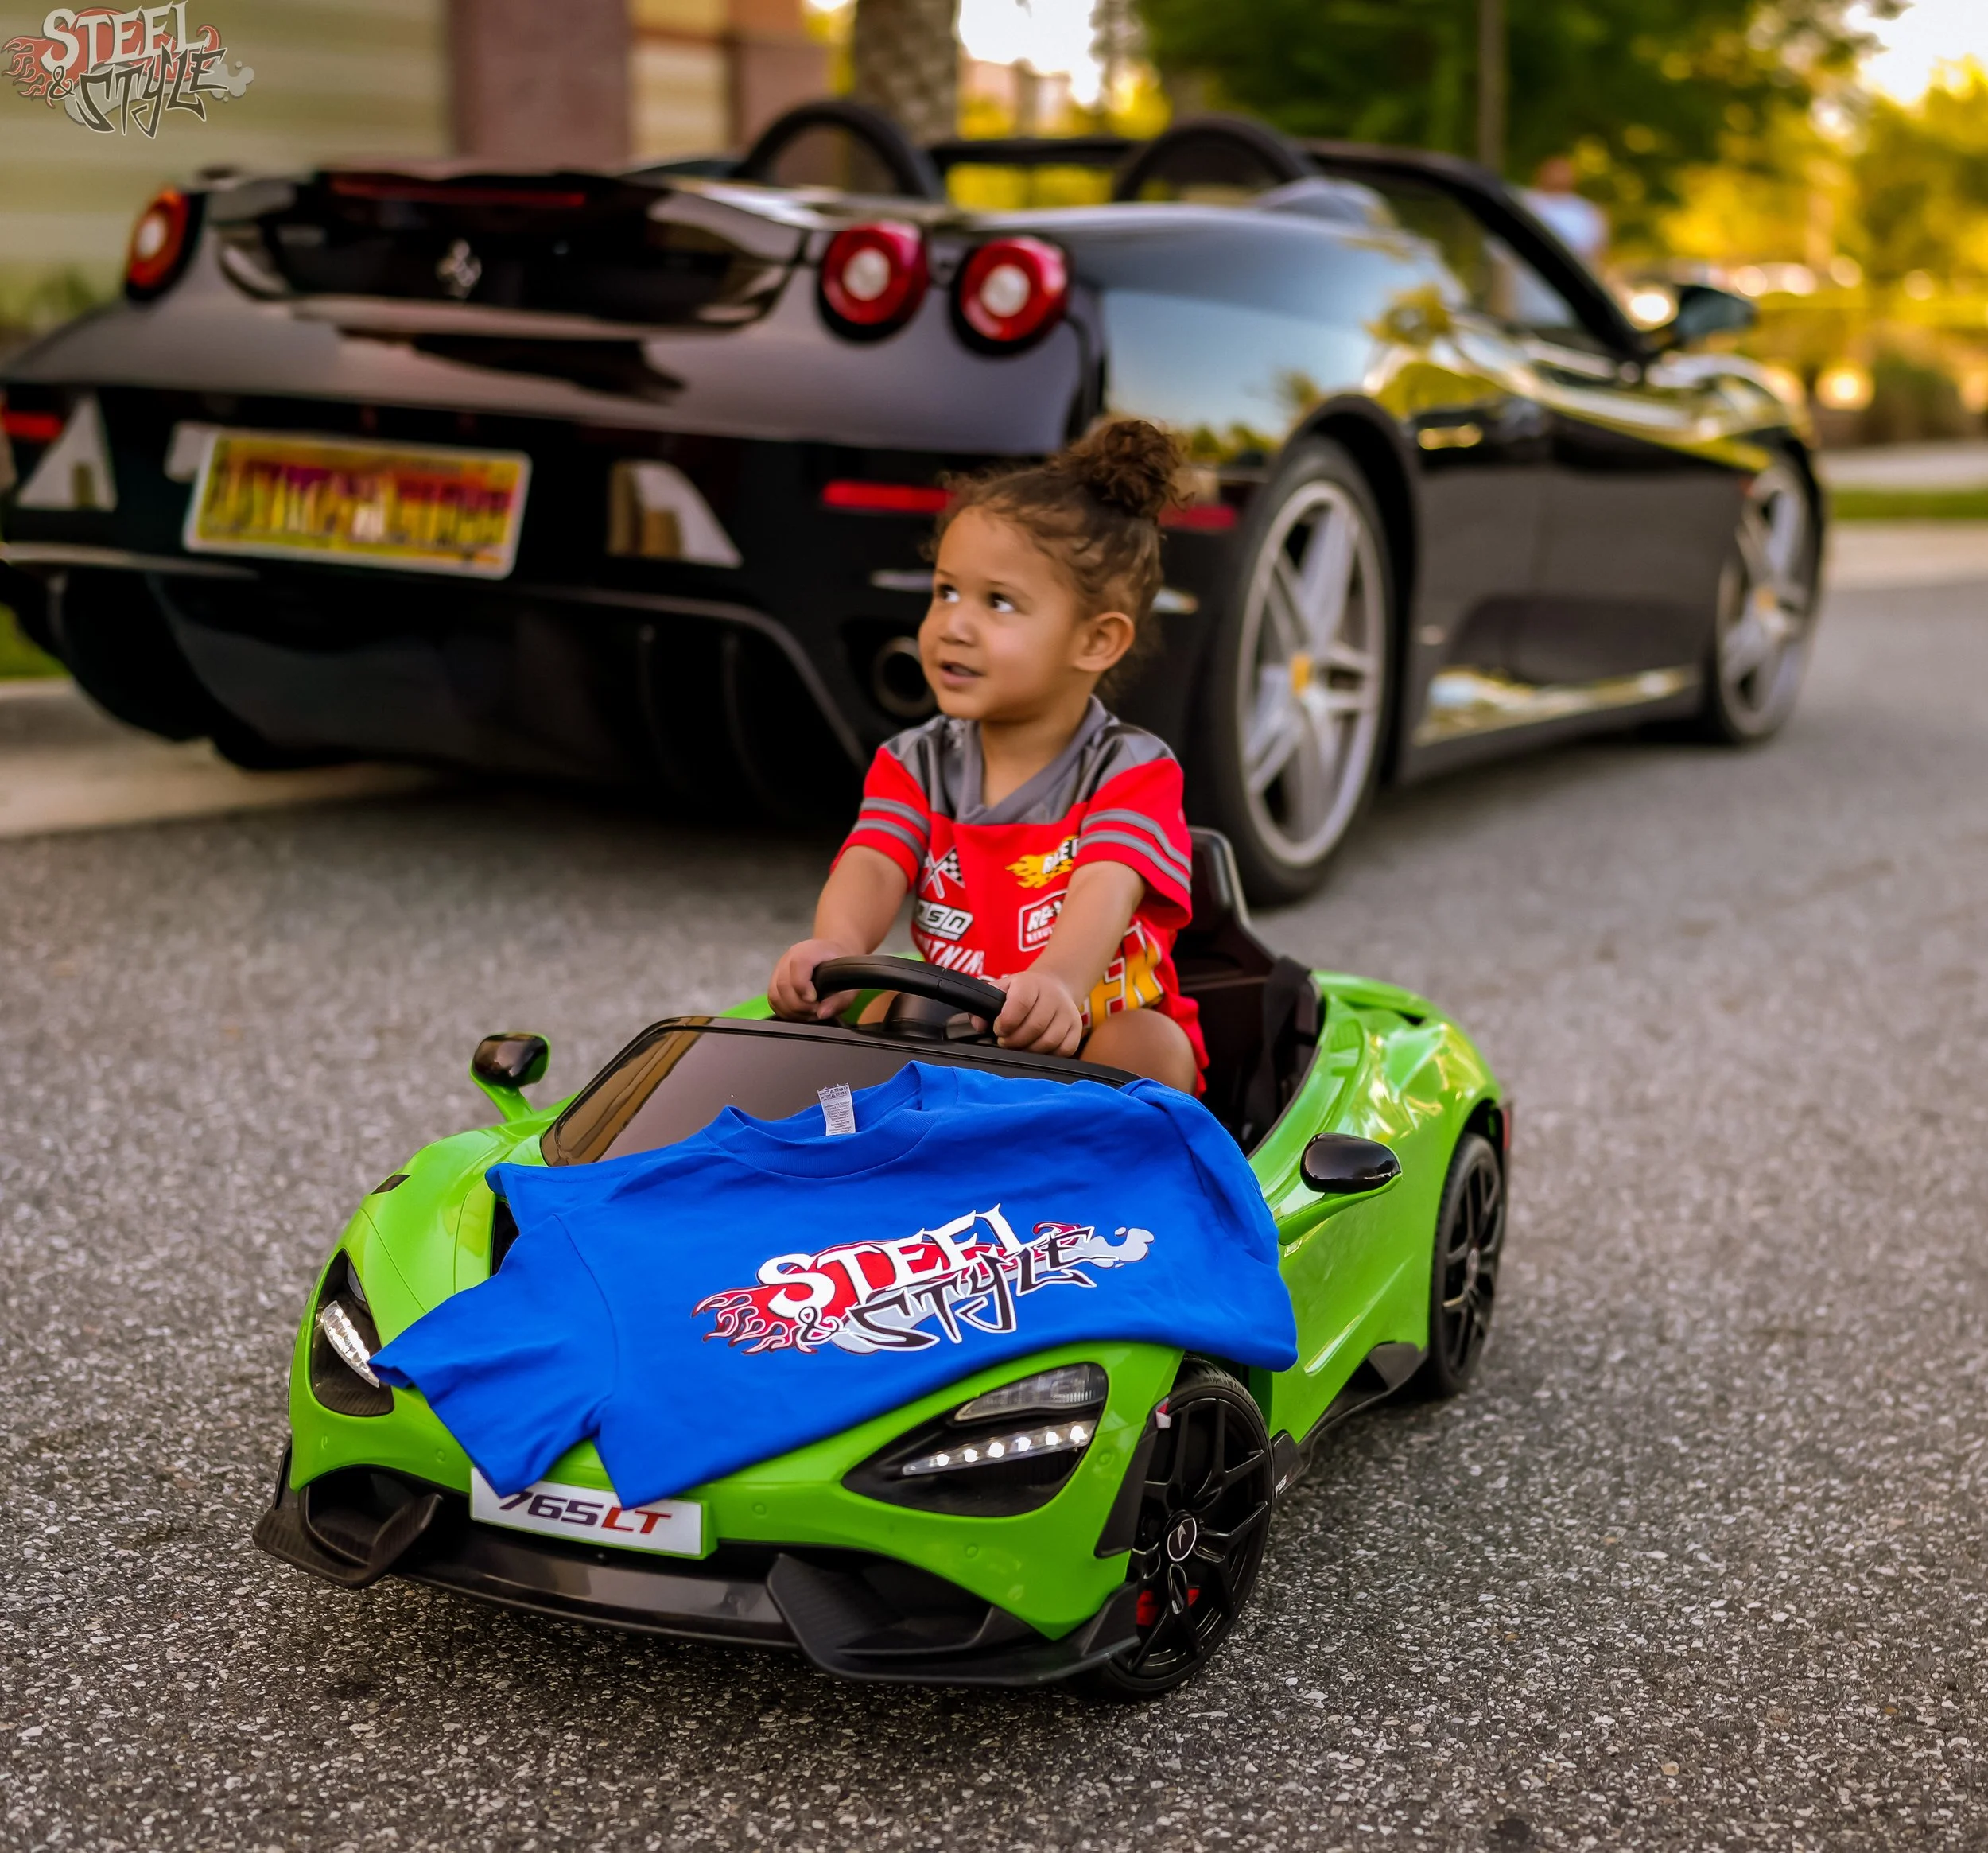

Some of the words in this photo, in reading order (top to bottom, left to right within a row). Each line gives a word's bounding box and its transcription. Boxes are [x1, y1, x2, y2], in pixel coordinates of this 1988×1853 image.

[756, 1203, 1058, 1319] STEEL
[796, 1306, 848, 1344] &
[845, 1226, 1120, 1351] STYLE
